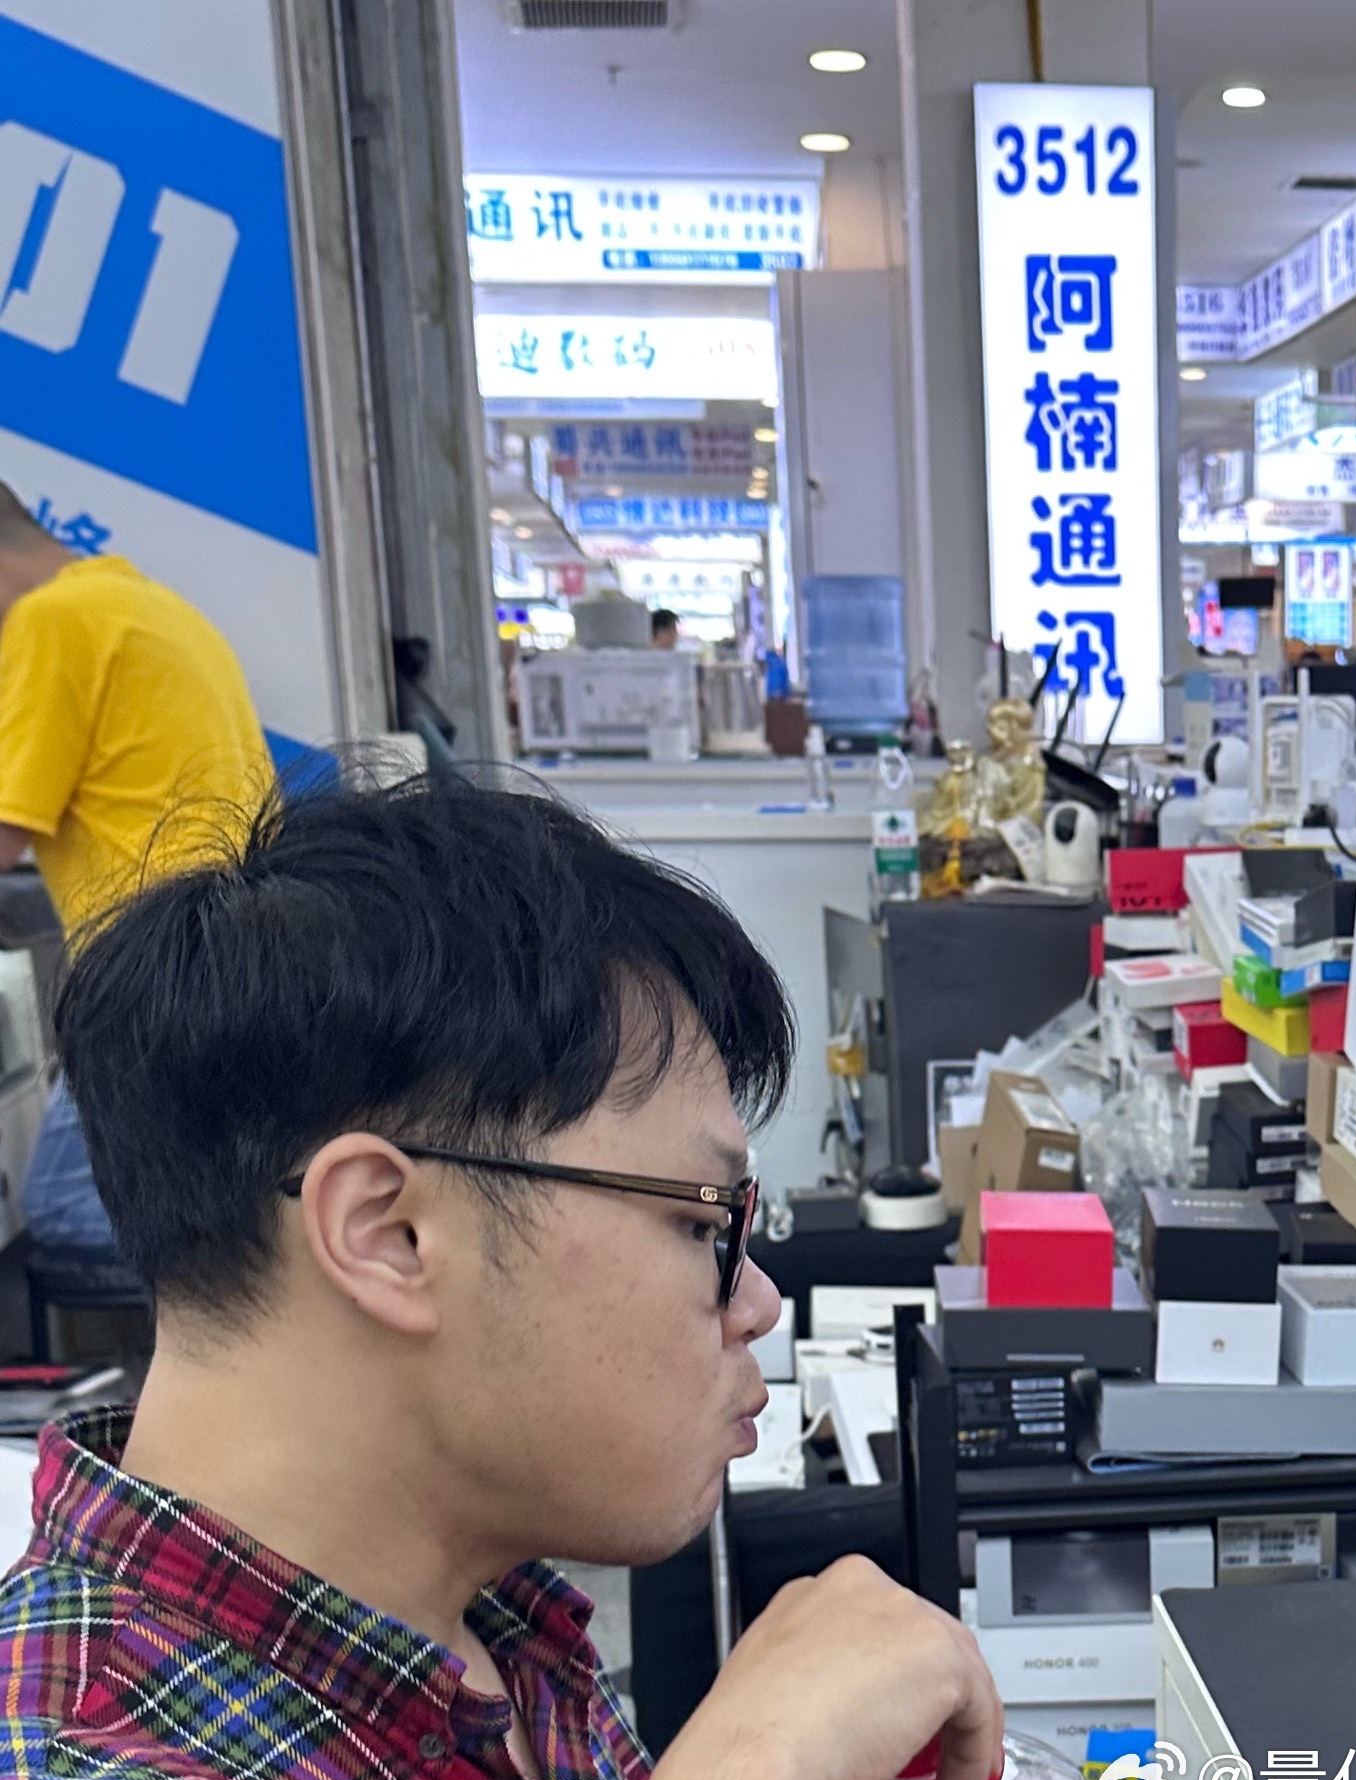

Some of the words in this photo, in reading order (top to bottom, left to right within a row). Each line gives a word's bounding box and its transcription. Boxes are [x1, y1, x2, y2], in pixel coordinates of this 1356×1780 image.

[994, 125, 1139, 196] 3512
[1023, 253, 1125, 699] 阿楠通讯
[1024, 1657, 1074, 1669] HONOR
